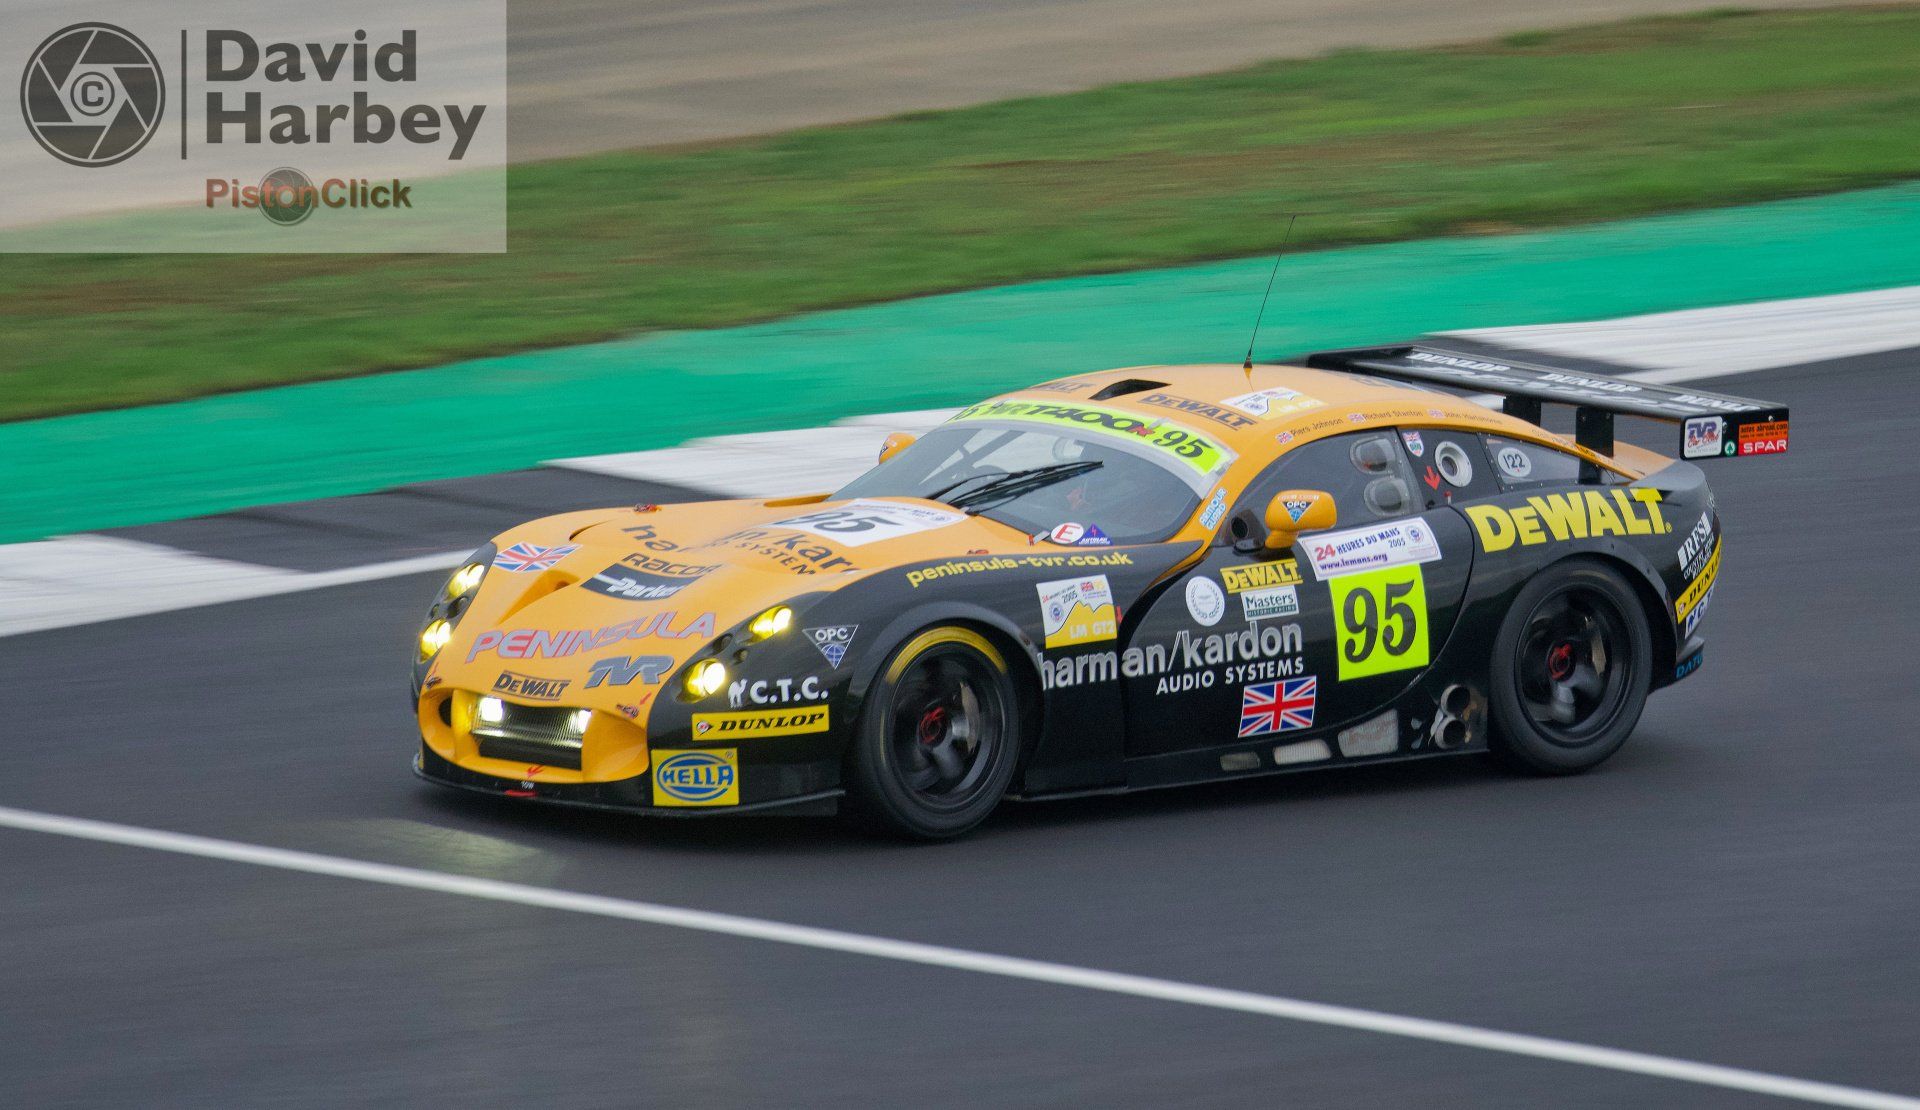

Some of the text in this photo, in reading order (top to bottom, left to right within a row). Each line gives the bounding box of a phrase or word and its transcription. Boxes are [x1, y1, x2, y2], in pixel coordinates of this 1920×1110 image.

[1405, 353, 1511, 372] DUNLOP
[1536, 373, 1642, 393] DUNLOP
[1670, 394, 1761, 412] DUNLOP
[1687, 422, 1717, 439] TVR
[1152, 430, 1212, 458] 95
[1743, 440, 1787, 453] SPAR
[1503, 454, 1526, 470] 122
[1286, 501, 1307, 509] OPC
[1053, 525, 1081, 542] E
[1388, 537, 1406, 549] 2005
[1315, 527, 1401, 562] 24 HEURES DU MANS
[906, 552, 1133, 588] peninsula-tvr.co.uk
[1319, 552, 1388, 571] www.lemans.org
[1245, 592, 1294, 609] Masters
[1070, 621, 1115, 639] LM GT2
[1343, 579, 1417, 664] 95
[464, 611, 717, 664] PENINSULA
[815, 627, 848, 642] OPC
[1037, 621, 1303, 692] harman/kardon
[583, 655, 675, 689] TVR
[1156, 656, 1304, 696] AUDIO SYSTEMS
[750, 676, 829, 704] C.T.C.
[718, 712, 825, 732] DUNLOP
[662, 765, 734, 786] HELLA
